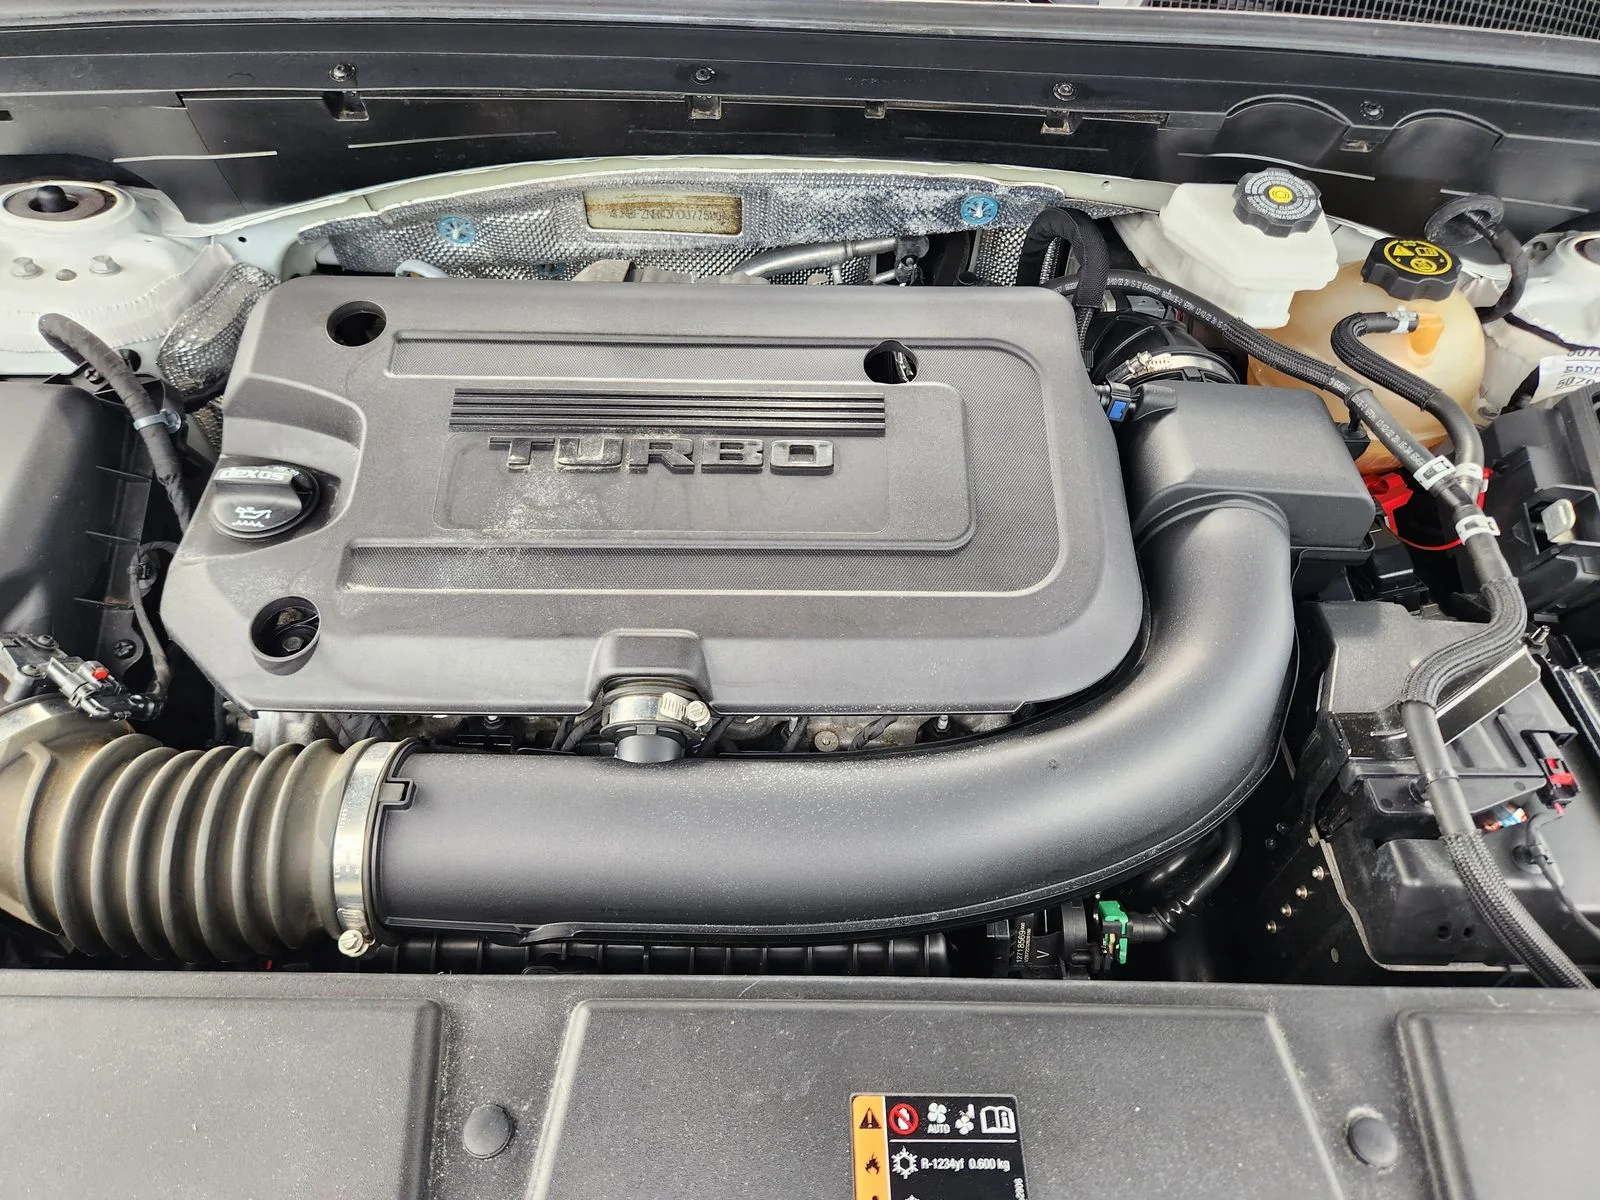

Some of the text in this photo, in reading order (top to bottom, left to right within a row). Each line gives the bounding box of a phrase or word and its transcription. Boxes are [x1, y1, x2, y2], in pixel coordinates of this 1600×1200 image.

[489, 436, 834, 473] TURBO
[219, 467, 285, 481] dexos
[927, 1123, 950, 1134] AUTO
[920, 1157, 1011, 1172] R-1234yf 0.600 kg
